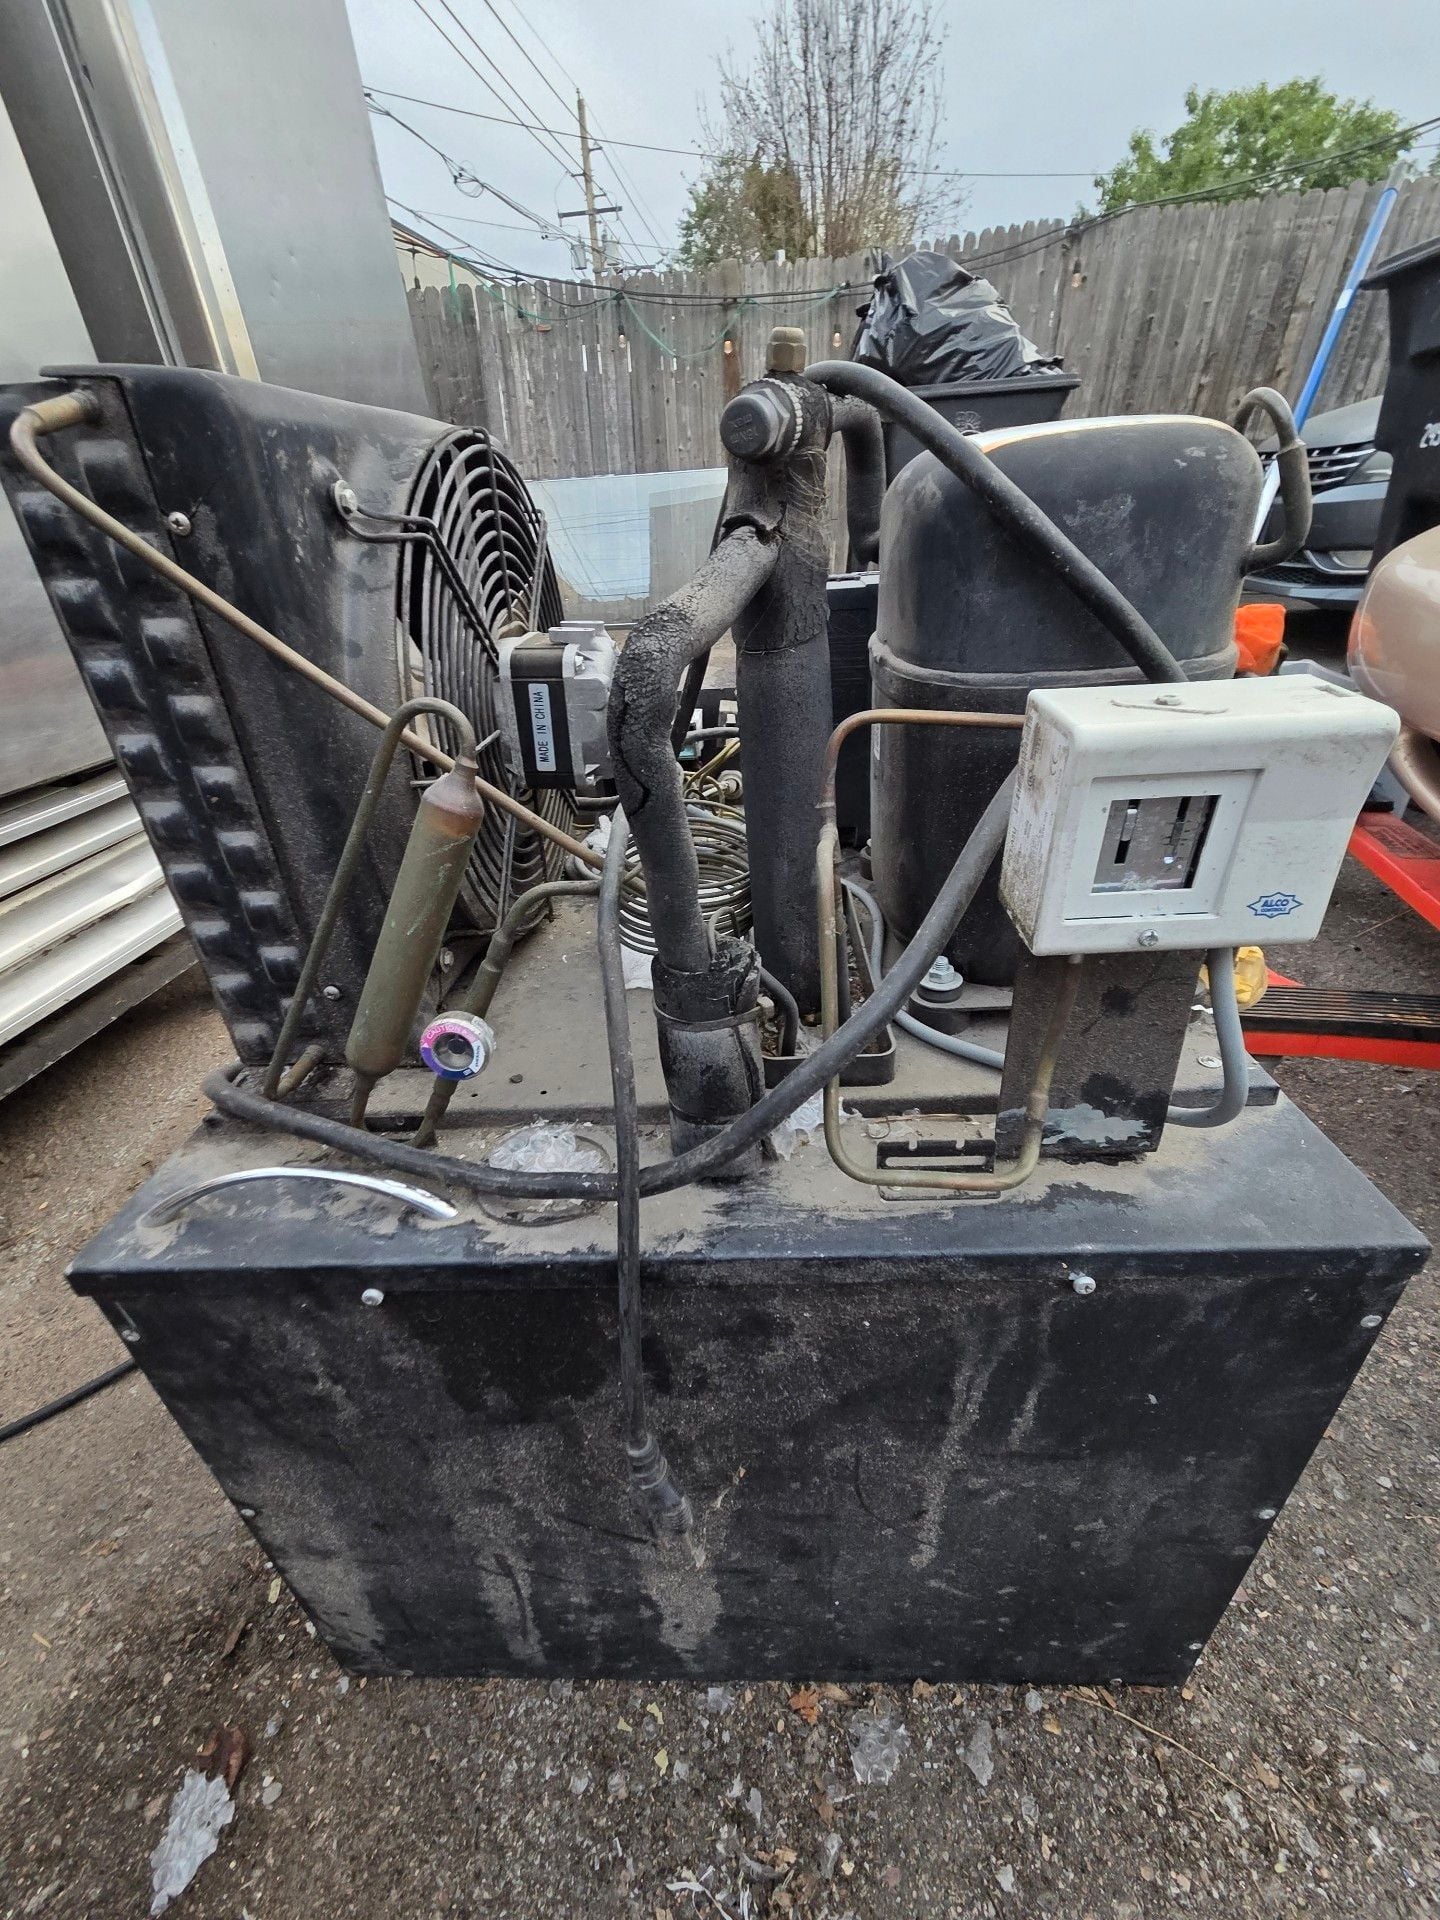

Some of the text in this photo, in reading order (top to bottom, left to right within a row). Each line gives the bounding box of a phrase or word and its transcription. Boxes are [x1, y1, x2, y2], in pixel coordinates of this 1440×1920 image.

[533, 691, 549, 762] MADE IN CHINA
[1261, 899, 1289, 907] ALCO
[426, 1024, 462, 1040] CAUTION
